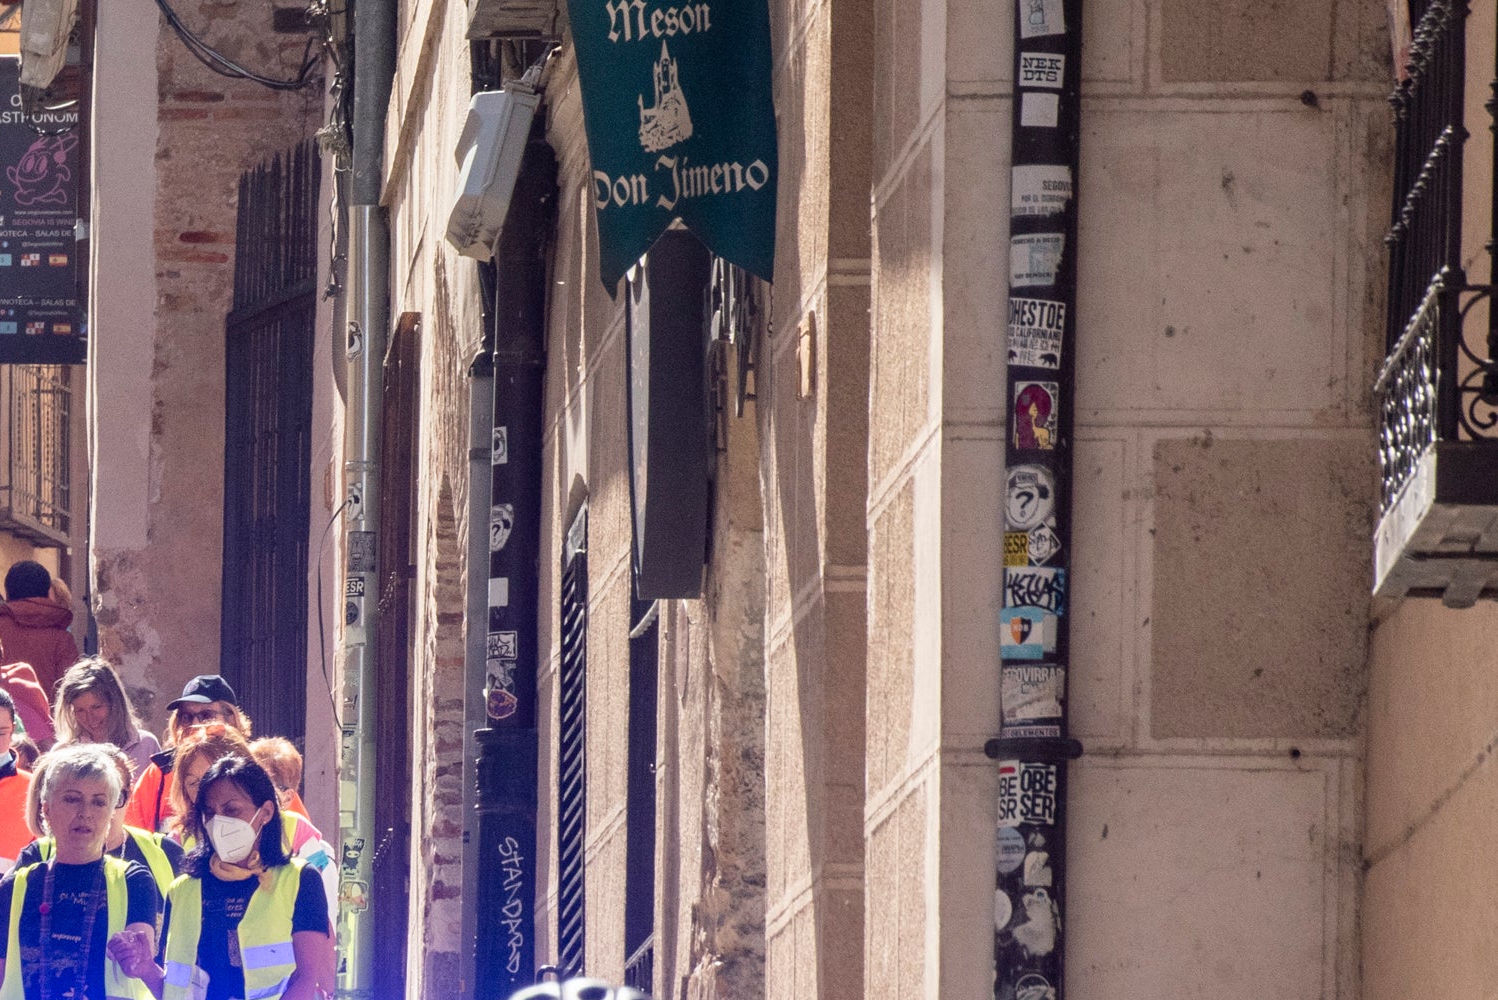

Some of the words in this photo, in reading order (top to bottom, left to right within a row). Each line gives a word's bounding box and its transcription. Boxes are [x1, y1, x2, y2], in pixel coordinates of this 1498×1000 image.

[1023, 58, 1062, 70] NEK
[1023, 70, 1058, 82] DTS
[593, 170, 650, 210] Don
[35, 230, 60, 238] SALAS
[1020, 769, 1054, 794] OBE
[1020, 794, 1053, 819] SER
